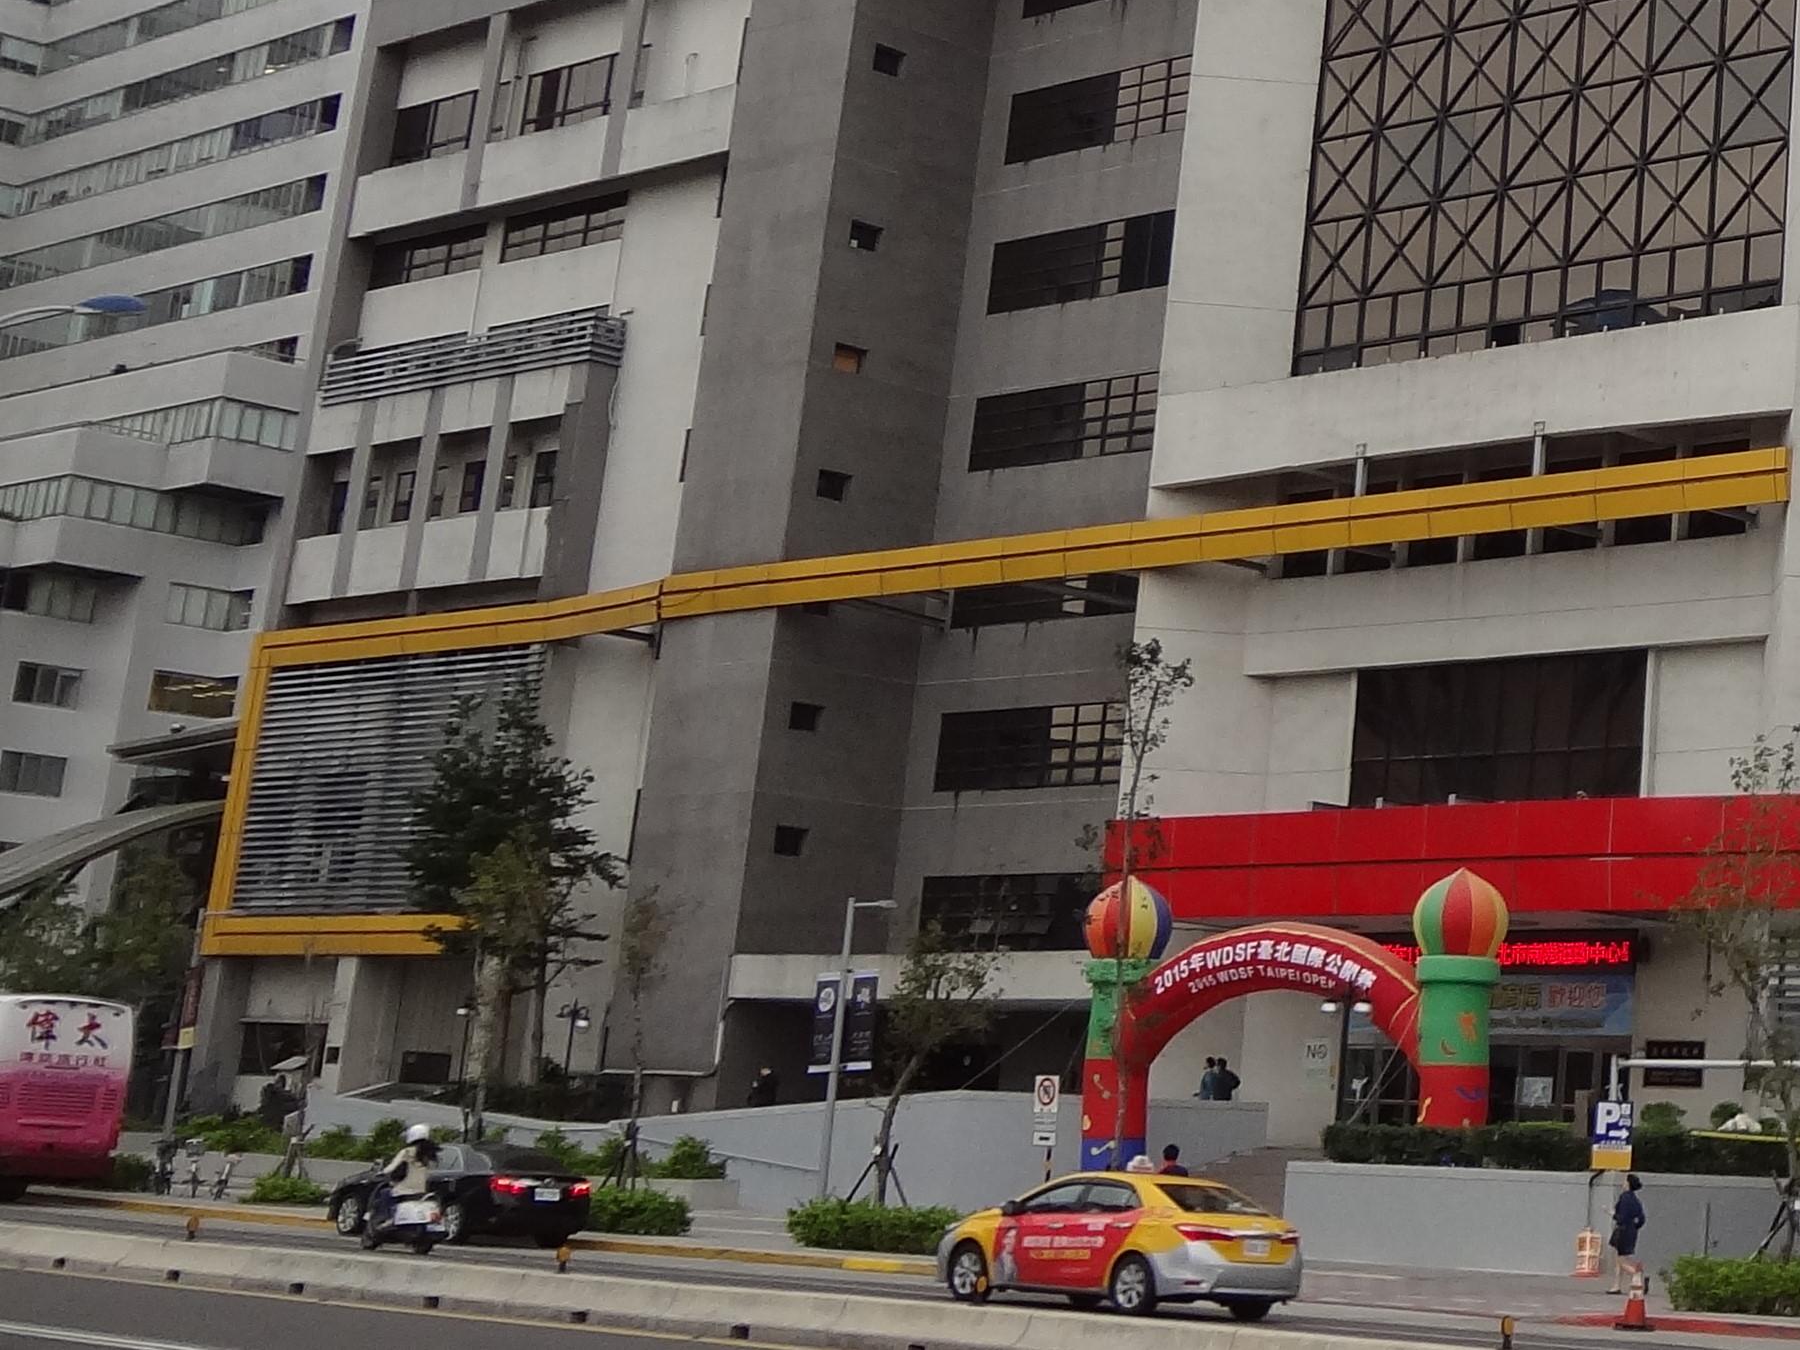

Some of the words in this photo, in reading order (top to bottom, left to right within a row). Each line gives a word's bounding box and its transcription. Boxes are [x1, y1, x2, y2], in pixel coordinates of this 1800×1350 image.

[1188, 975, 1217, 994] 2015
[1217, 965, 1254, 983] WDSF
[1258, 964, 1300, 986] TAIPEI
[1596, 1102, 1621, 1135] P
